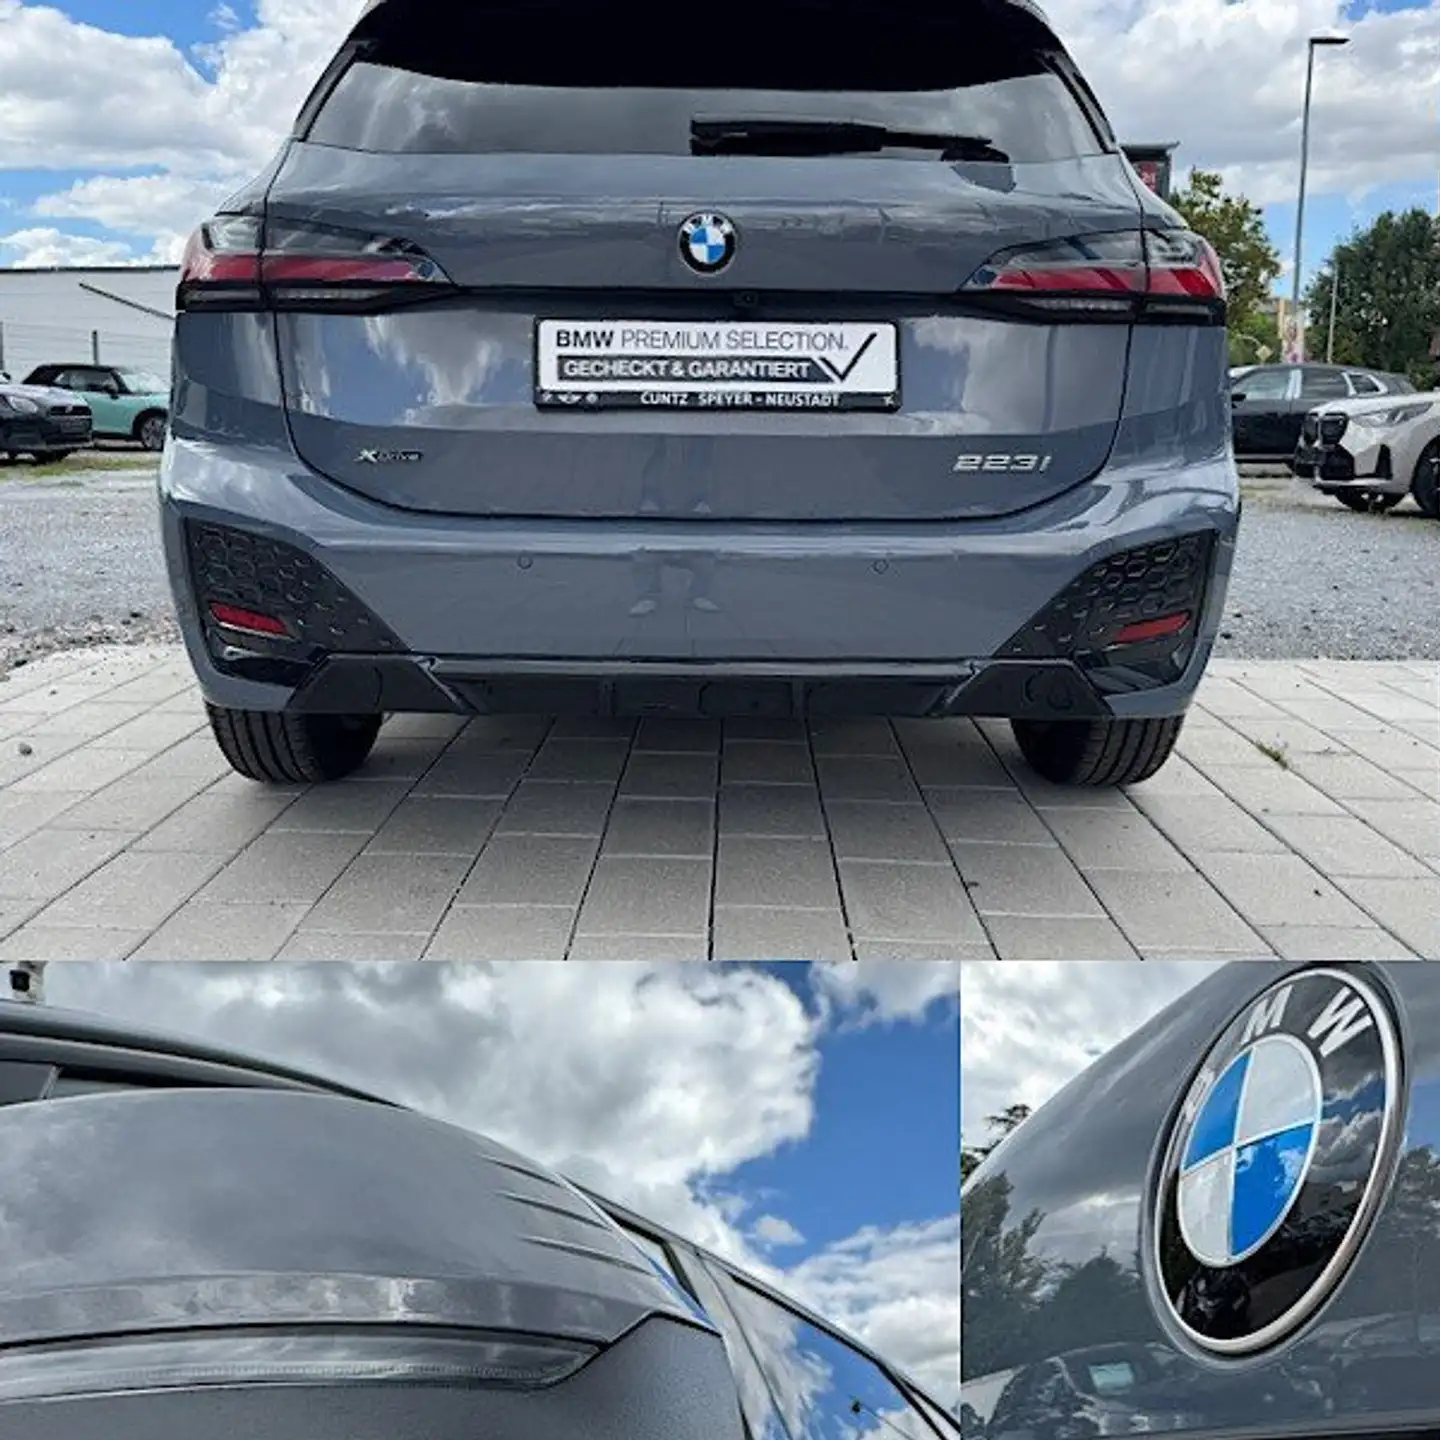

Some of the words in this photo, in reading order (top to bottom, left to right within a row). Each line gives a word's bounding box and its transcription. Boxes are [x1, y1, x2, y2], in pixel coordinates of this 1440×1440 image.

[556, 330, 614, 348] BMW
[621, 330, 719, 350] PREMIUM
[563, 360, 668, 377] GECHECKT
[671, 361, 683, 376] &
[689, 361, 810, 378] GARANTIERT
[640, 393, 688, 406] CUNTZ
[698, 393, 751, 407] SPEYER
[765, 393, 840, 407] NEUSTADT
